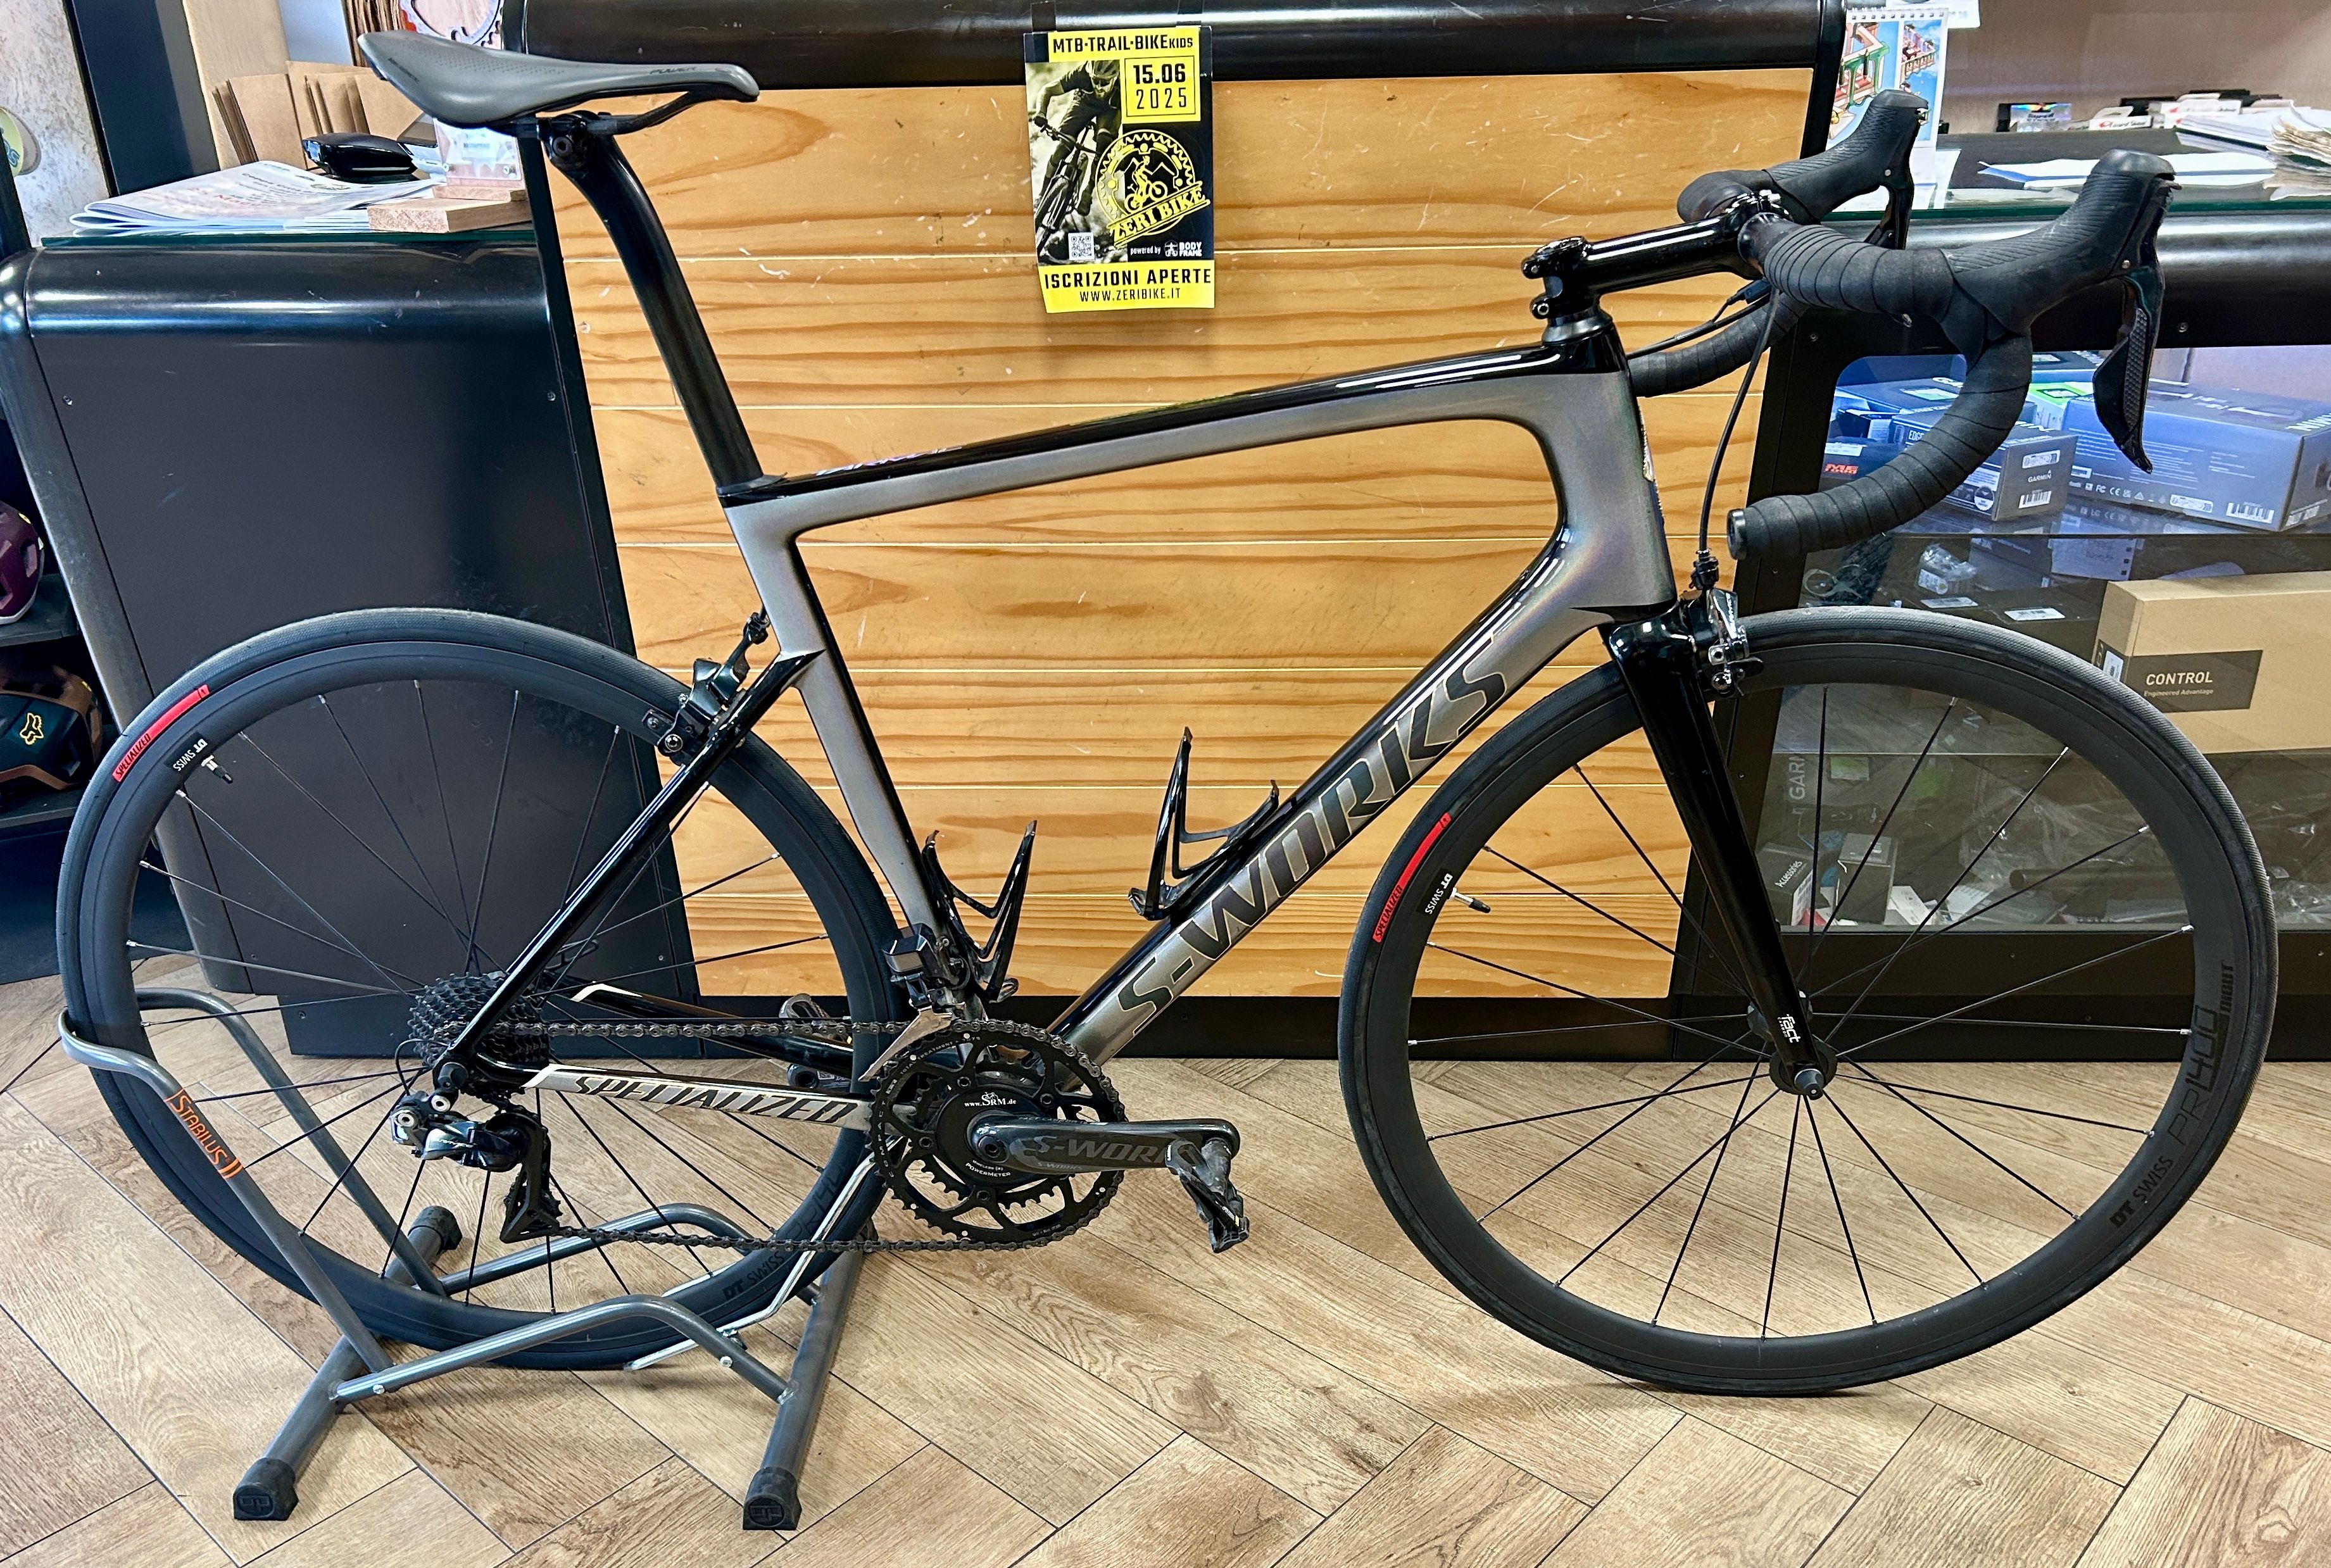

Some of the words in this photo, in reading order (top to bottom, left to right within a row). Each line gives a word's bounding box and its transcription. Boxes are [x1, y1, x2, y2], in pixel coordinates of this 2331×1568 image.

[1133, 63, 1186, 85] 15.06
[1136, 87, 1187, 110] 2025
[1109, 209, 1159, 239] ZERI
[1159, 188, 1206, 220] BIKE
[1130, 245, 1154, 256] powered
[1154, 245, 1162, 255] by
[1179, 241, 1203, 250] BODY
[1179, 249, 1203, 258] FRAME
[1045, 270, 1138, 289] ISCRIZIONI
[1147, 268, 1212, 284] APERTE
[1079, 287, 1181, 303] WWW.ZERIBIKE.IT
[2028, 473, 2052, 483] GARMIN
[2146, 672, 2213, 686] CONTROL
[2180, 688, 2214, 696] Advantage
[115, 732, 152, 777] SPECIALIZED
[193, 738, 208, 753] DT
[173, 749, 196, 772] SWISS
[1115, 636, 1509, 1037] S-WORKS
[1440, 873, 1454, 889] DT
[1374, 884, 1404, 938] SPECIALIZED
[1424, 887, 1444, 915] SWISS
[1781, 1013, 1801, 1043] fact
[574, 1075, 859, 1124] SPECIALIZED
[169, 1094, 230, 1165] STABILUS
[2109, 1199, 2135, 1229] DT
[2133, 1156, 2174, 1205] SWISS
[722, 1279, 745, 1300] DT
[746, 1250, 786, 1286] SWISS
